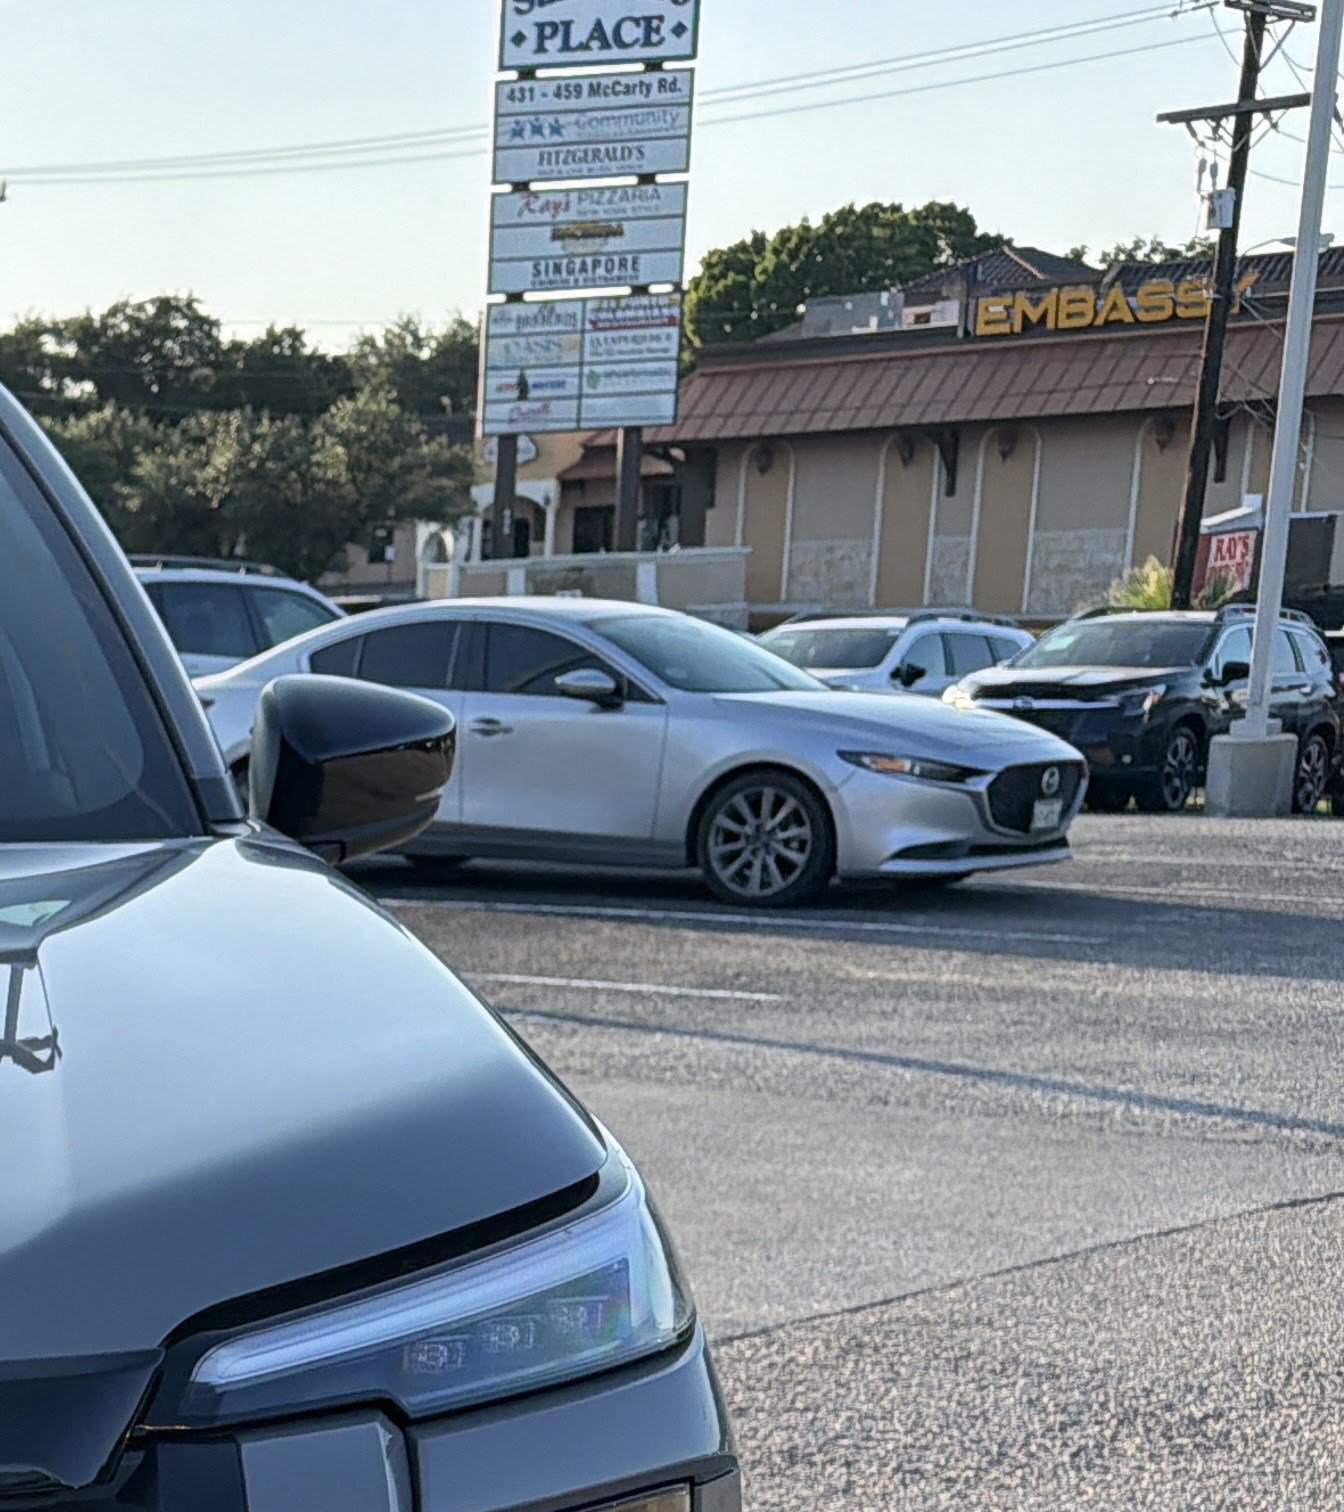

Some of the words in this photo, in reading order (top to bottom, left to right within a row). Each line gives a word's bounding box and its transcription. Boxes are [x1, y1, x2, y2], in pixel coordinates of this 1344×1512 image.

[533, 15, 665, 53] PLACE
[507, 86, 534, 103] 431
[553, 83, 582, 100] 459
[587, 78, 653, 98] McCarty
[657, 77, 682, 94] Rd.
[532, 256, 640, 278] SINGAPORE
